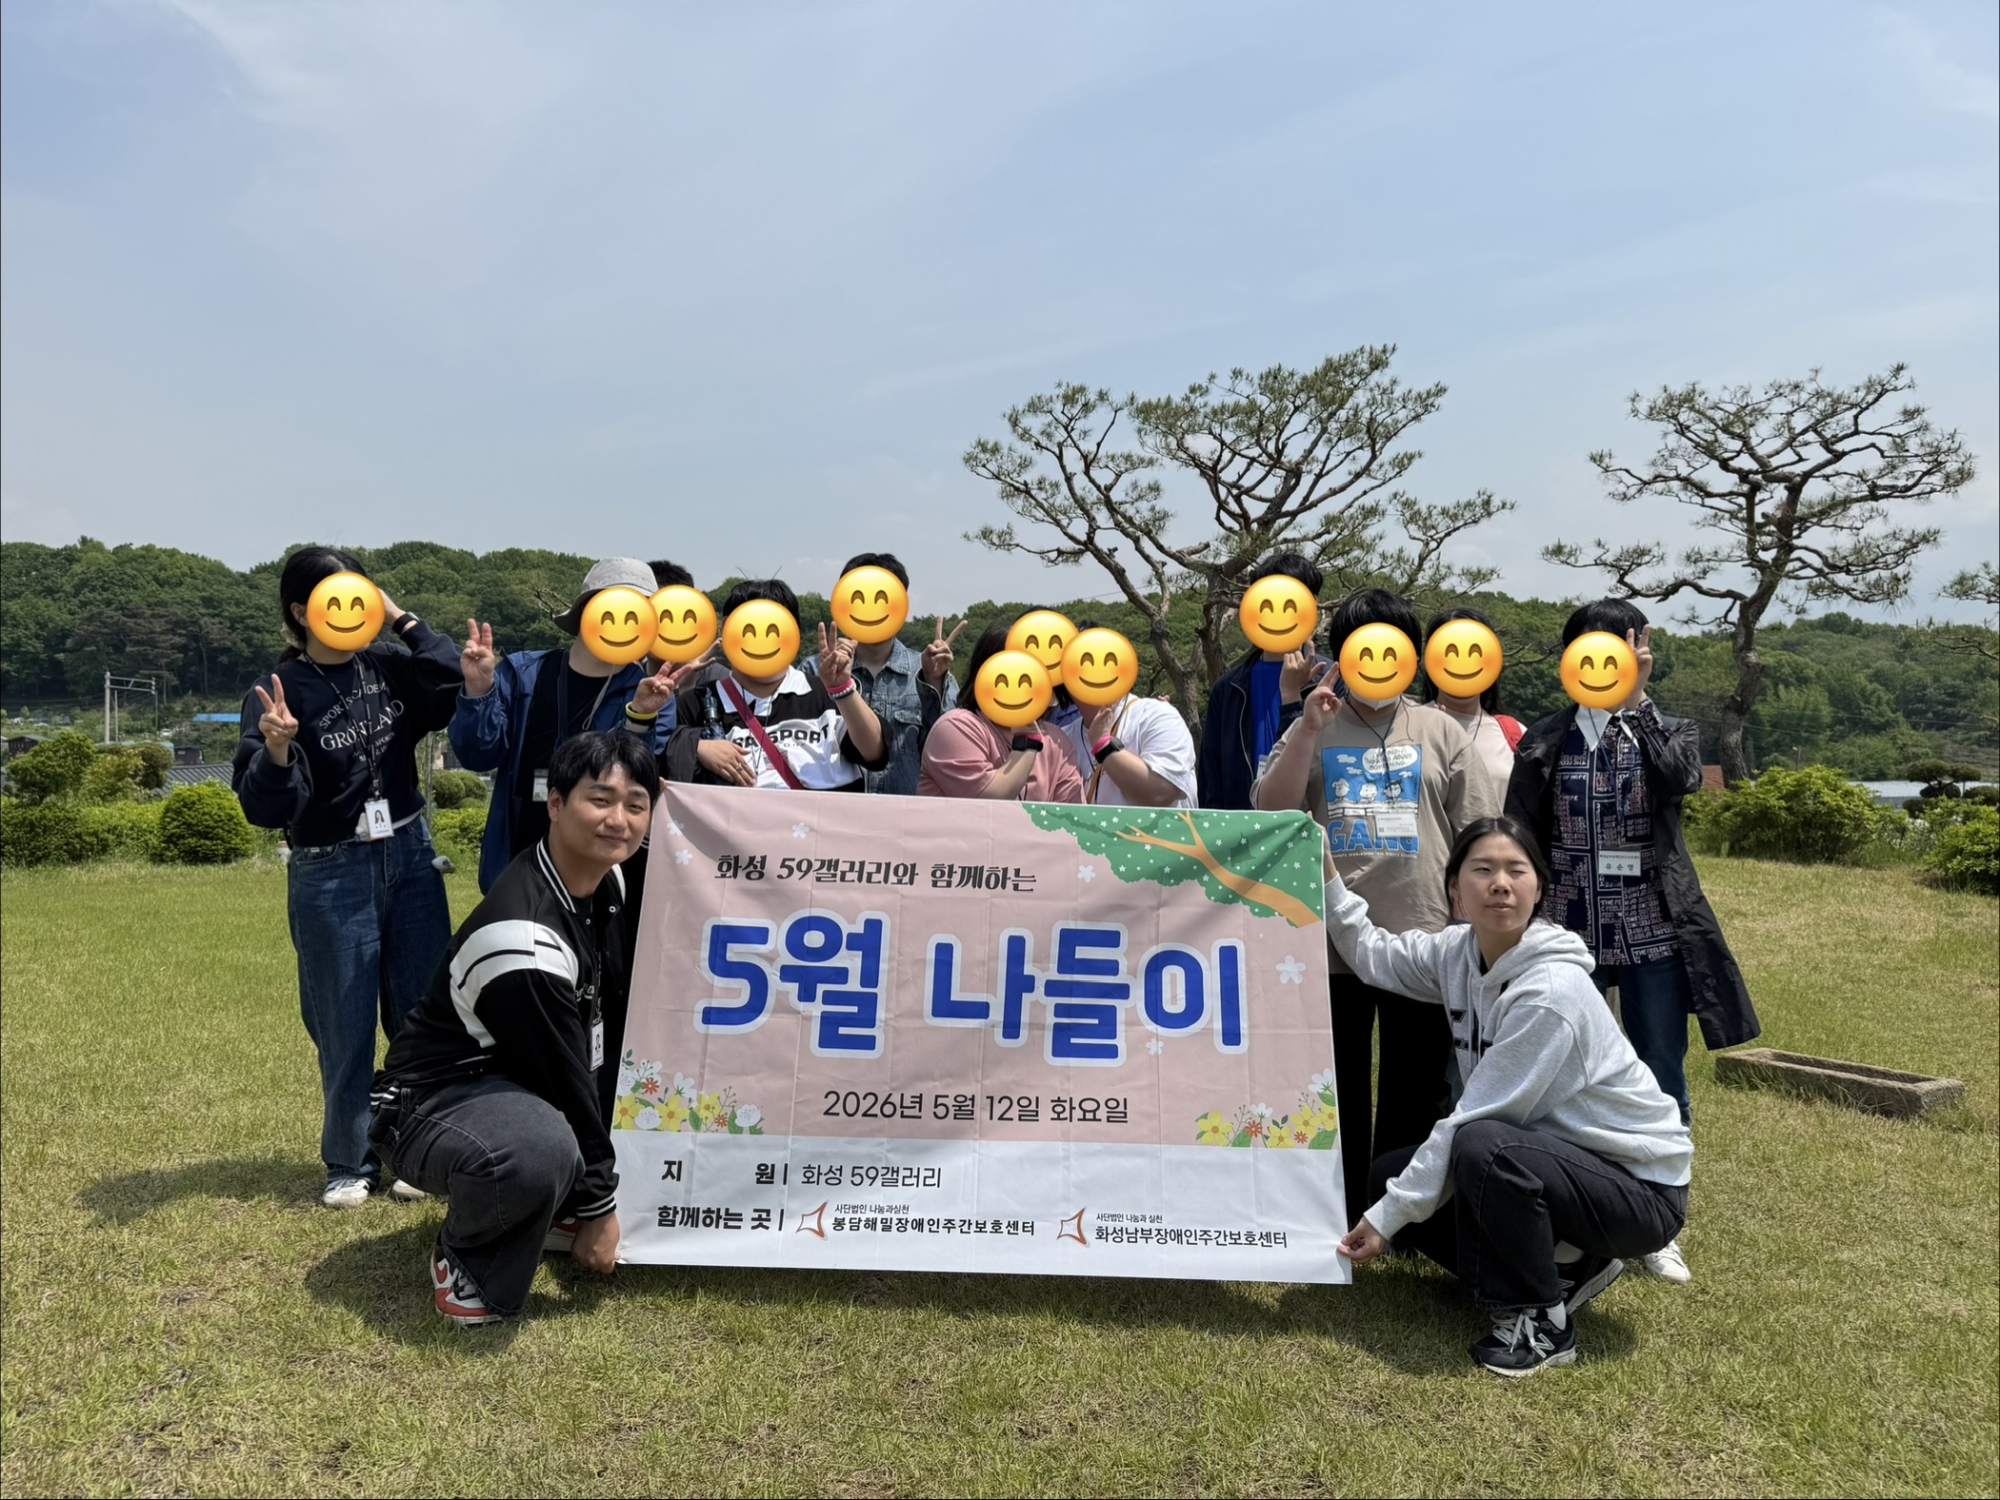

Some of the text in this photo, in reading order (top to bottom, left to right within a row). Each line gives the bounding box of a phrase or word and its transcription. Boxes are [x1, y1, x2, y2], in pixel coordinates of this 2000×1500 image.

[714, 854, 1037, 892] 화성 59갤러리와 함께하는
[700, 914, 1244, 1062] 5월 나들이
[822, 1090, 1129, 1124] 2026년 5월 12일 화요일
[661, 1159, 683, 1182] 지
[800, 1163, 942, 1189] 화성 59갤러리
[657, 1204, 744, 1230] 함께하는
[834, 1203, 867, 1214] 사단법인
[1096, 1213, 1124, 1223] 사단법인
[832, 1216, 1035, 1236] 봉담해밀장애인주간보호센터
[1095, 1225, 1287, 1249] 화성남부장애인주간보호센터
